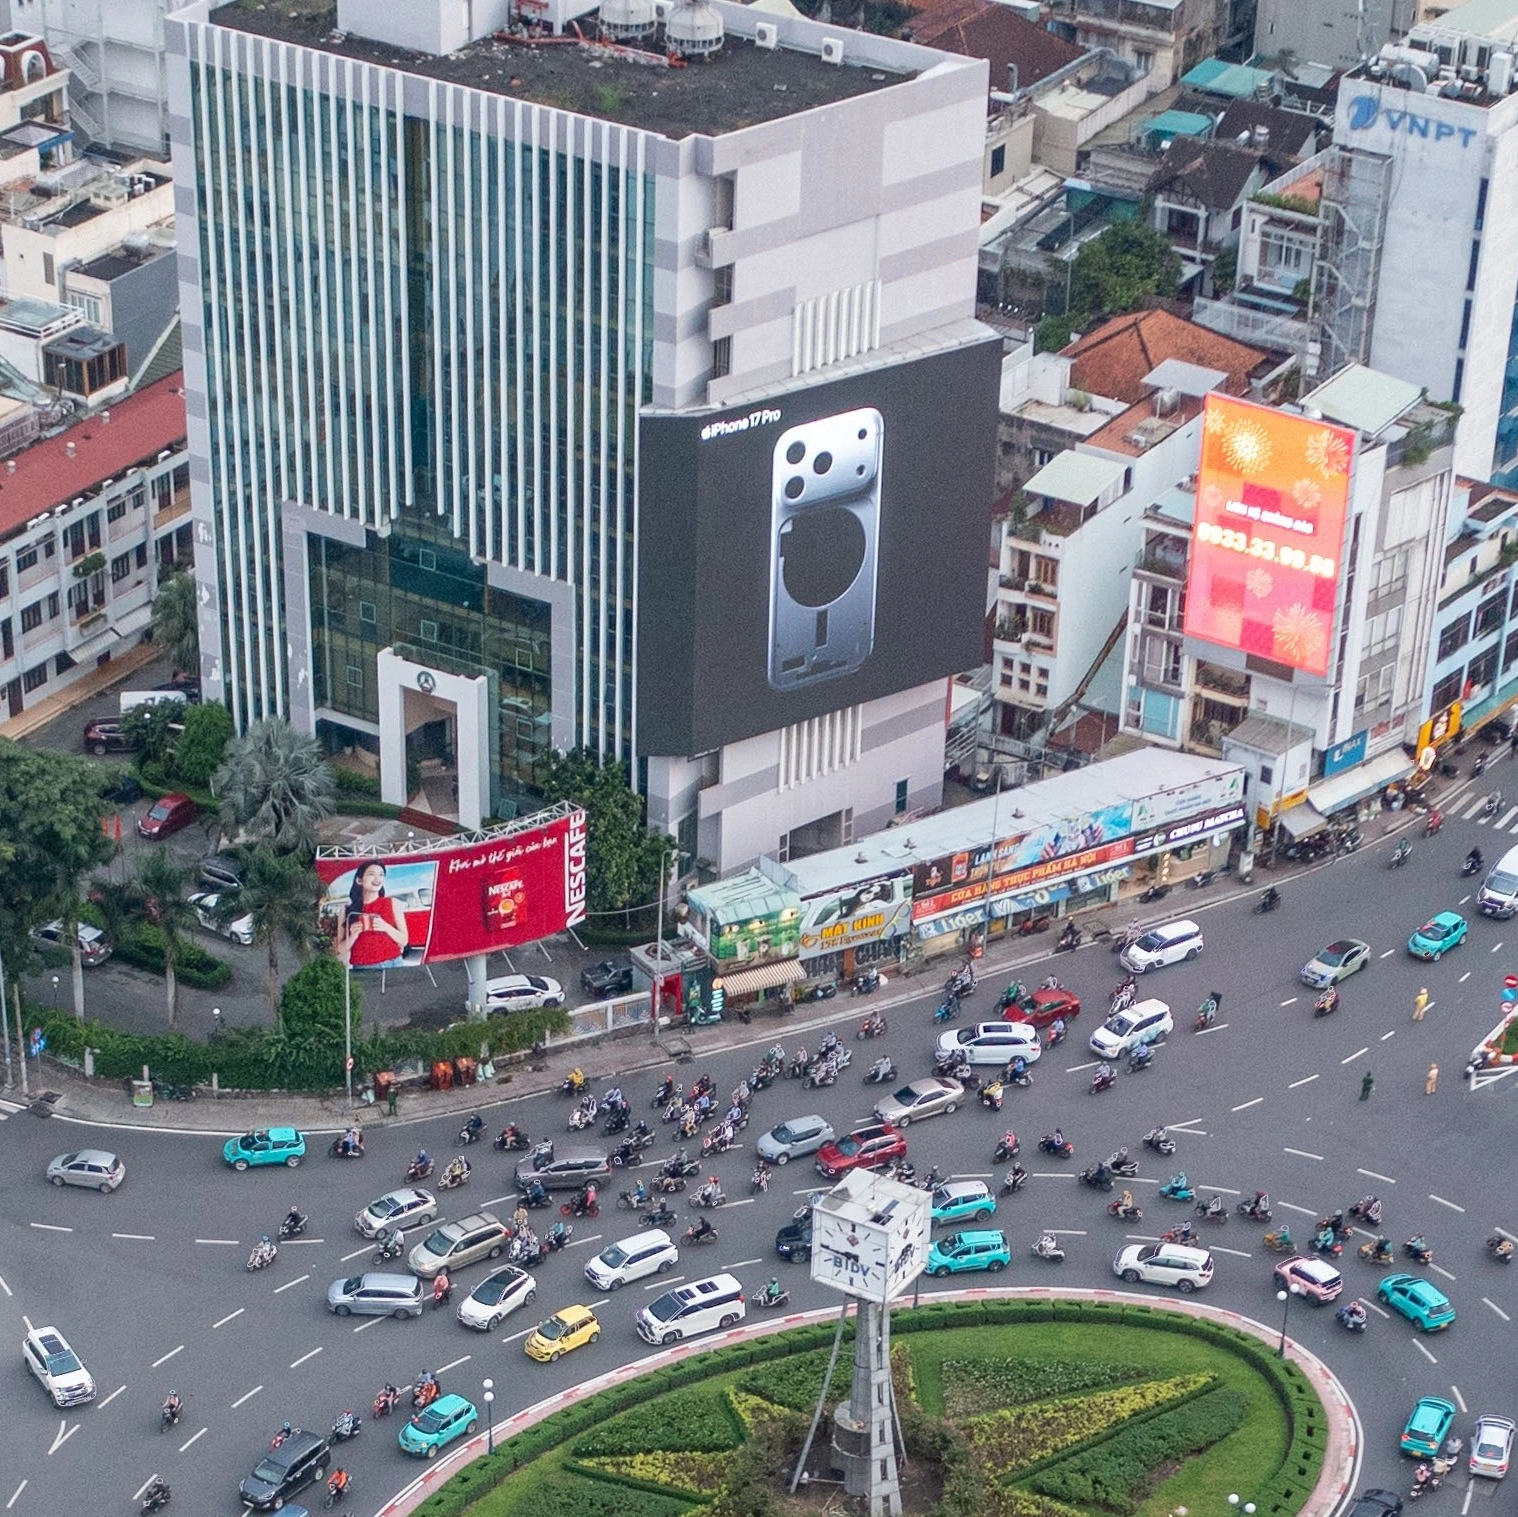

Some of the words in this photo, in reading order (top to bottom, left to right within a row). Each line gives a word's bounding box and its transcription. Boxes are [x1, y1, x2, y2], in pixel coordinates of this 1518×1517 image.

[1384, 108, 1478, 148] VNPT
[711, 417, 749, 438] iPhone
[749, 411, 761, 428] 17
[762, 409, 781, 425] Pro
[1093, 866, 1130, 887] Tiger
[938, 911, 983, 931] Tiger
